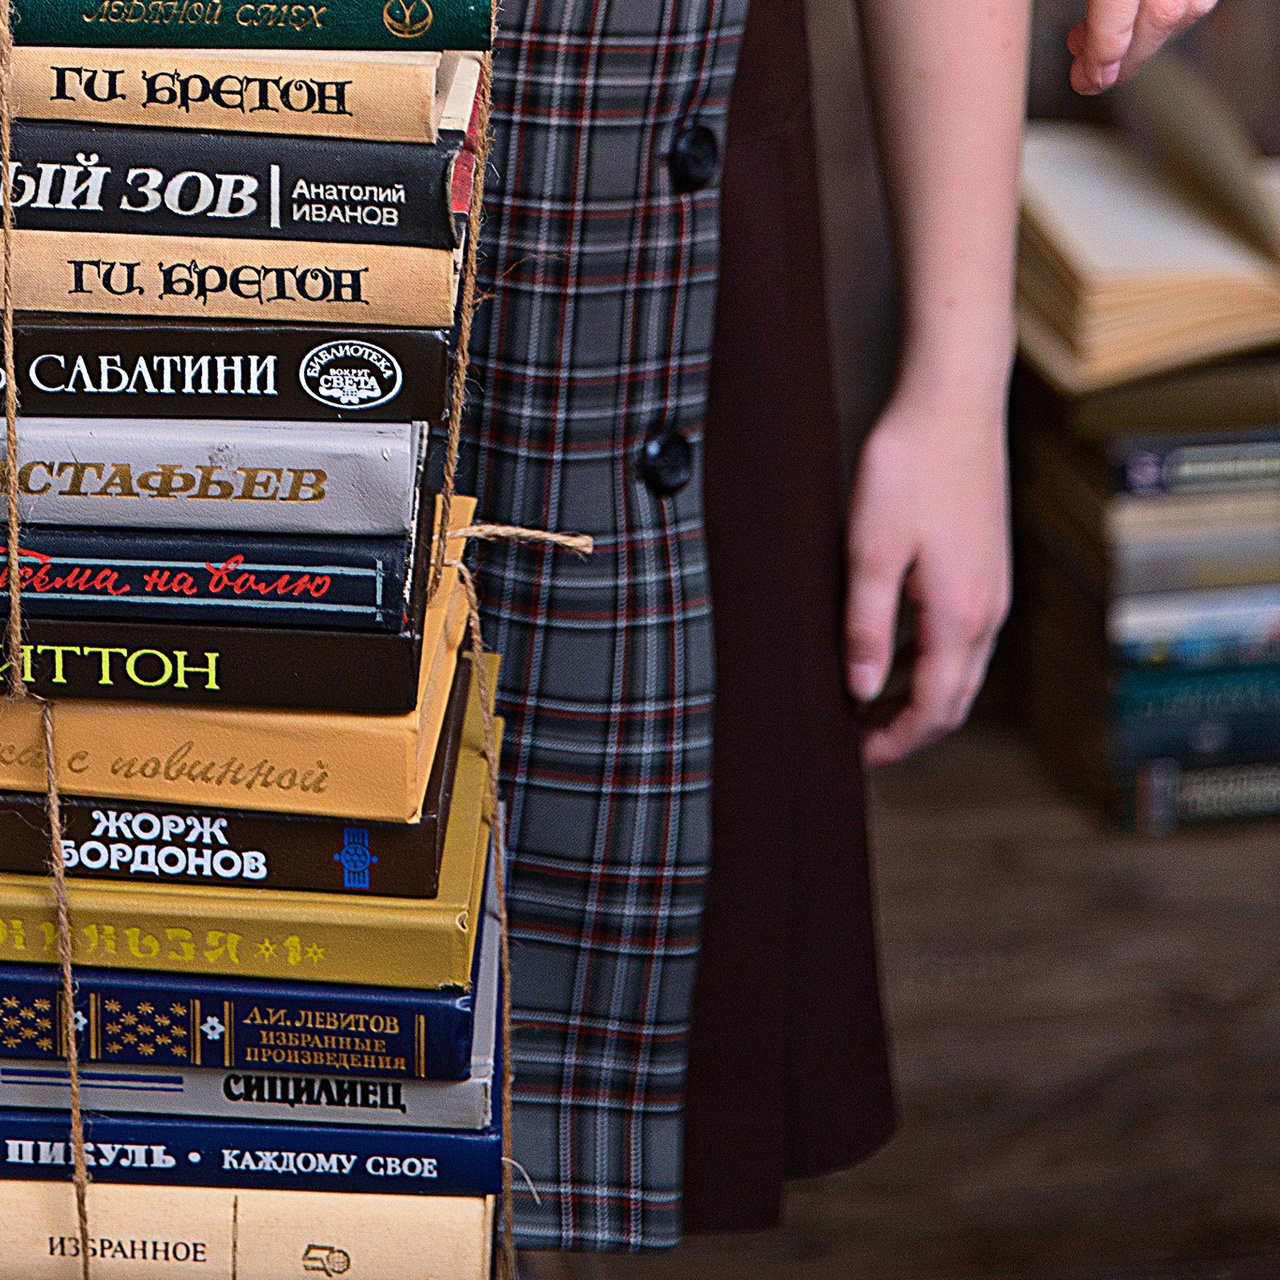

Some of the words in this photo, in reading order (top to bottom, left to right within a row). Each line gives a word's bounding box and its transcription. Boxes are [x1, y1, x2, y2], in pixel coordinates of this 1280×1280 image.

[235, 3, 328, 31] СМЕХ
[50, 66, 127, 103] ГИ
[141, 68, 354, 117] БРЕТОН
[120, 167, 259, 219] ЗОВ
[292, 178, 406, 204] Анатолий
[292, 203, 400, 227] ИВАНОВ
[67, 259, 144, 296] ГИ
[158, 259, 369, 306] БРЕТОН
[28, 354, 279, 395] САБАТИНИ
[306, 344, 394, 380] БИБЛИОТЕКА
[143, 565, 199, 596] на
[204, 552, 332, 599] волю
[66, 749, 90, 774] с
[110, 740, 330, 794] повинной
[91, 809, 229, 845] ЖОРЖ
[60, 840, 269, 881] БОРДОНОВ
[242, 1005, 292, 1027] А.И.
[294, 1008, 401, 1034] ЛЕВИТОВ
[245, 1046, 407, 1071] ПРОИЗВЕДЕНИЯ
[259, 1030, 387, 1053] ИЗБРАННЫЕ
[223, 1073, 407, 1114] СИЦИЛИЕЦ
[4, 1138, 177, 1168] ПИКУЛЬ
[221, 1148, 358, 1177] КАЖДОМУ
[365, 1154, 439, 1179] СВОЕ
[48, 1236, 207, 1263] ИЗБРАННОЕ
